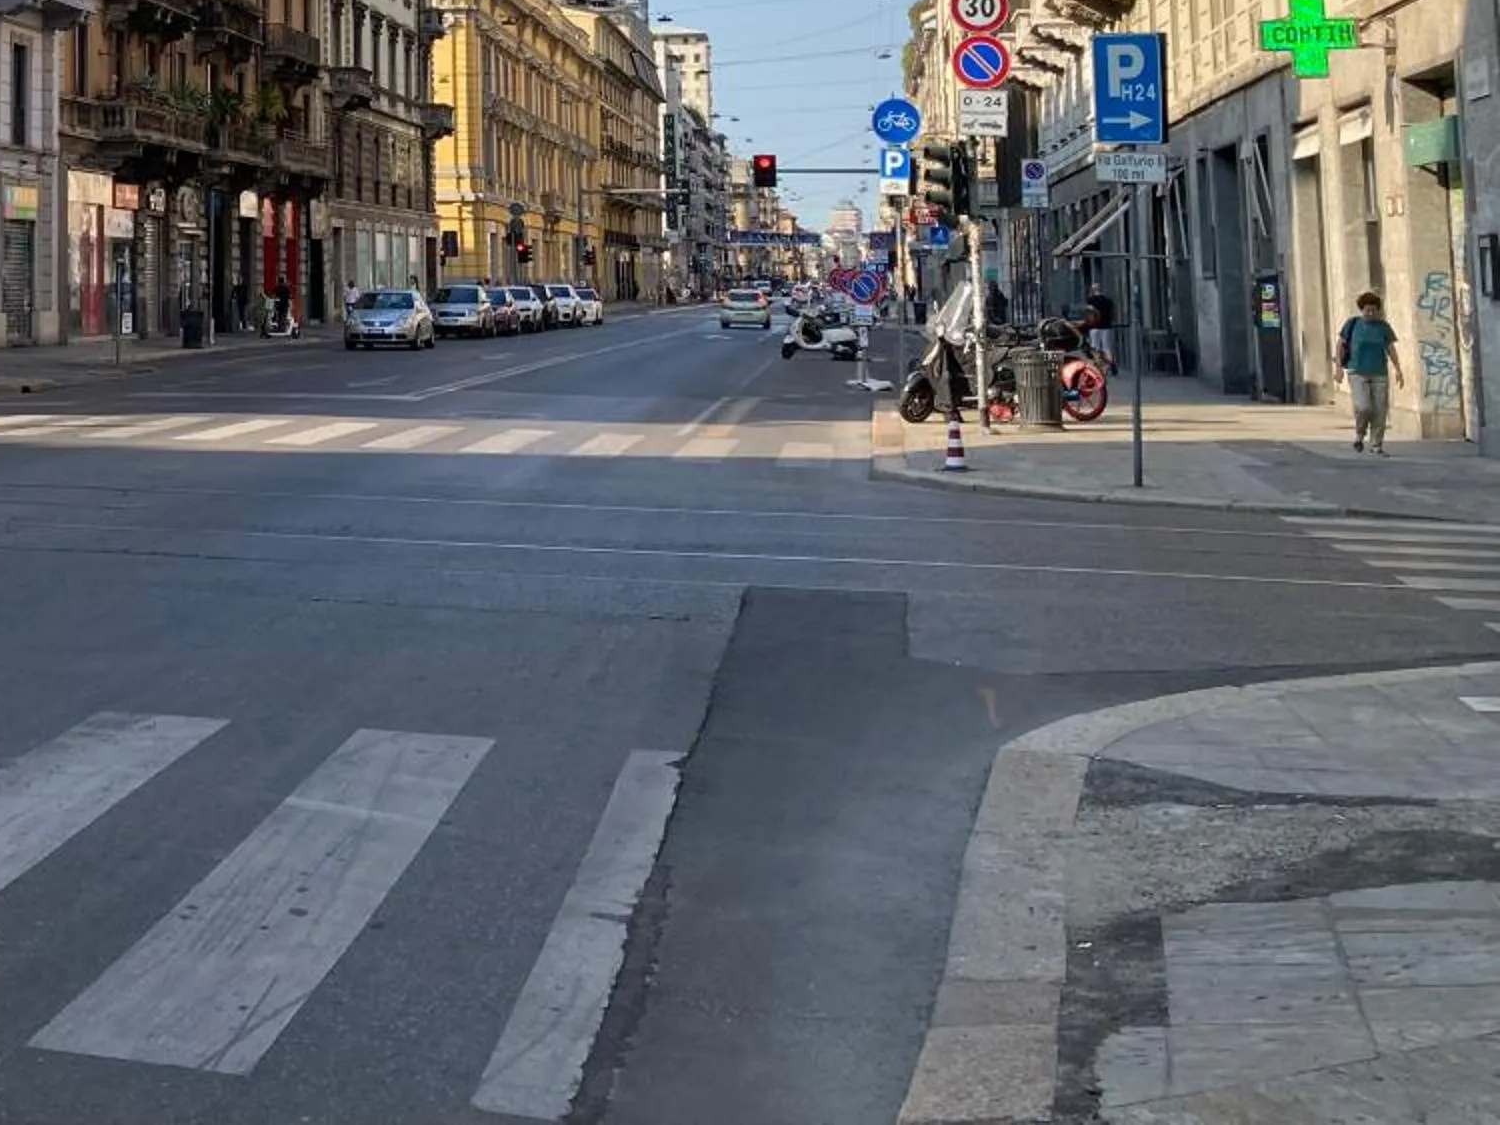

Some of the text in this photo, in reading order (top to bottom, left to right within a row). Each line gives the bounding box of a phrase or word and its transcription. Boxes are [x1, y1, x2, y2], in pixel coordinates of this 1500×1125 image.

[1106, 44, 1145, 98] P
[1121, 83, 1156, 102] H24
[885, 151, 904, 176] P
